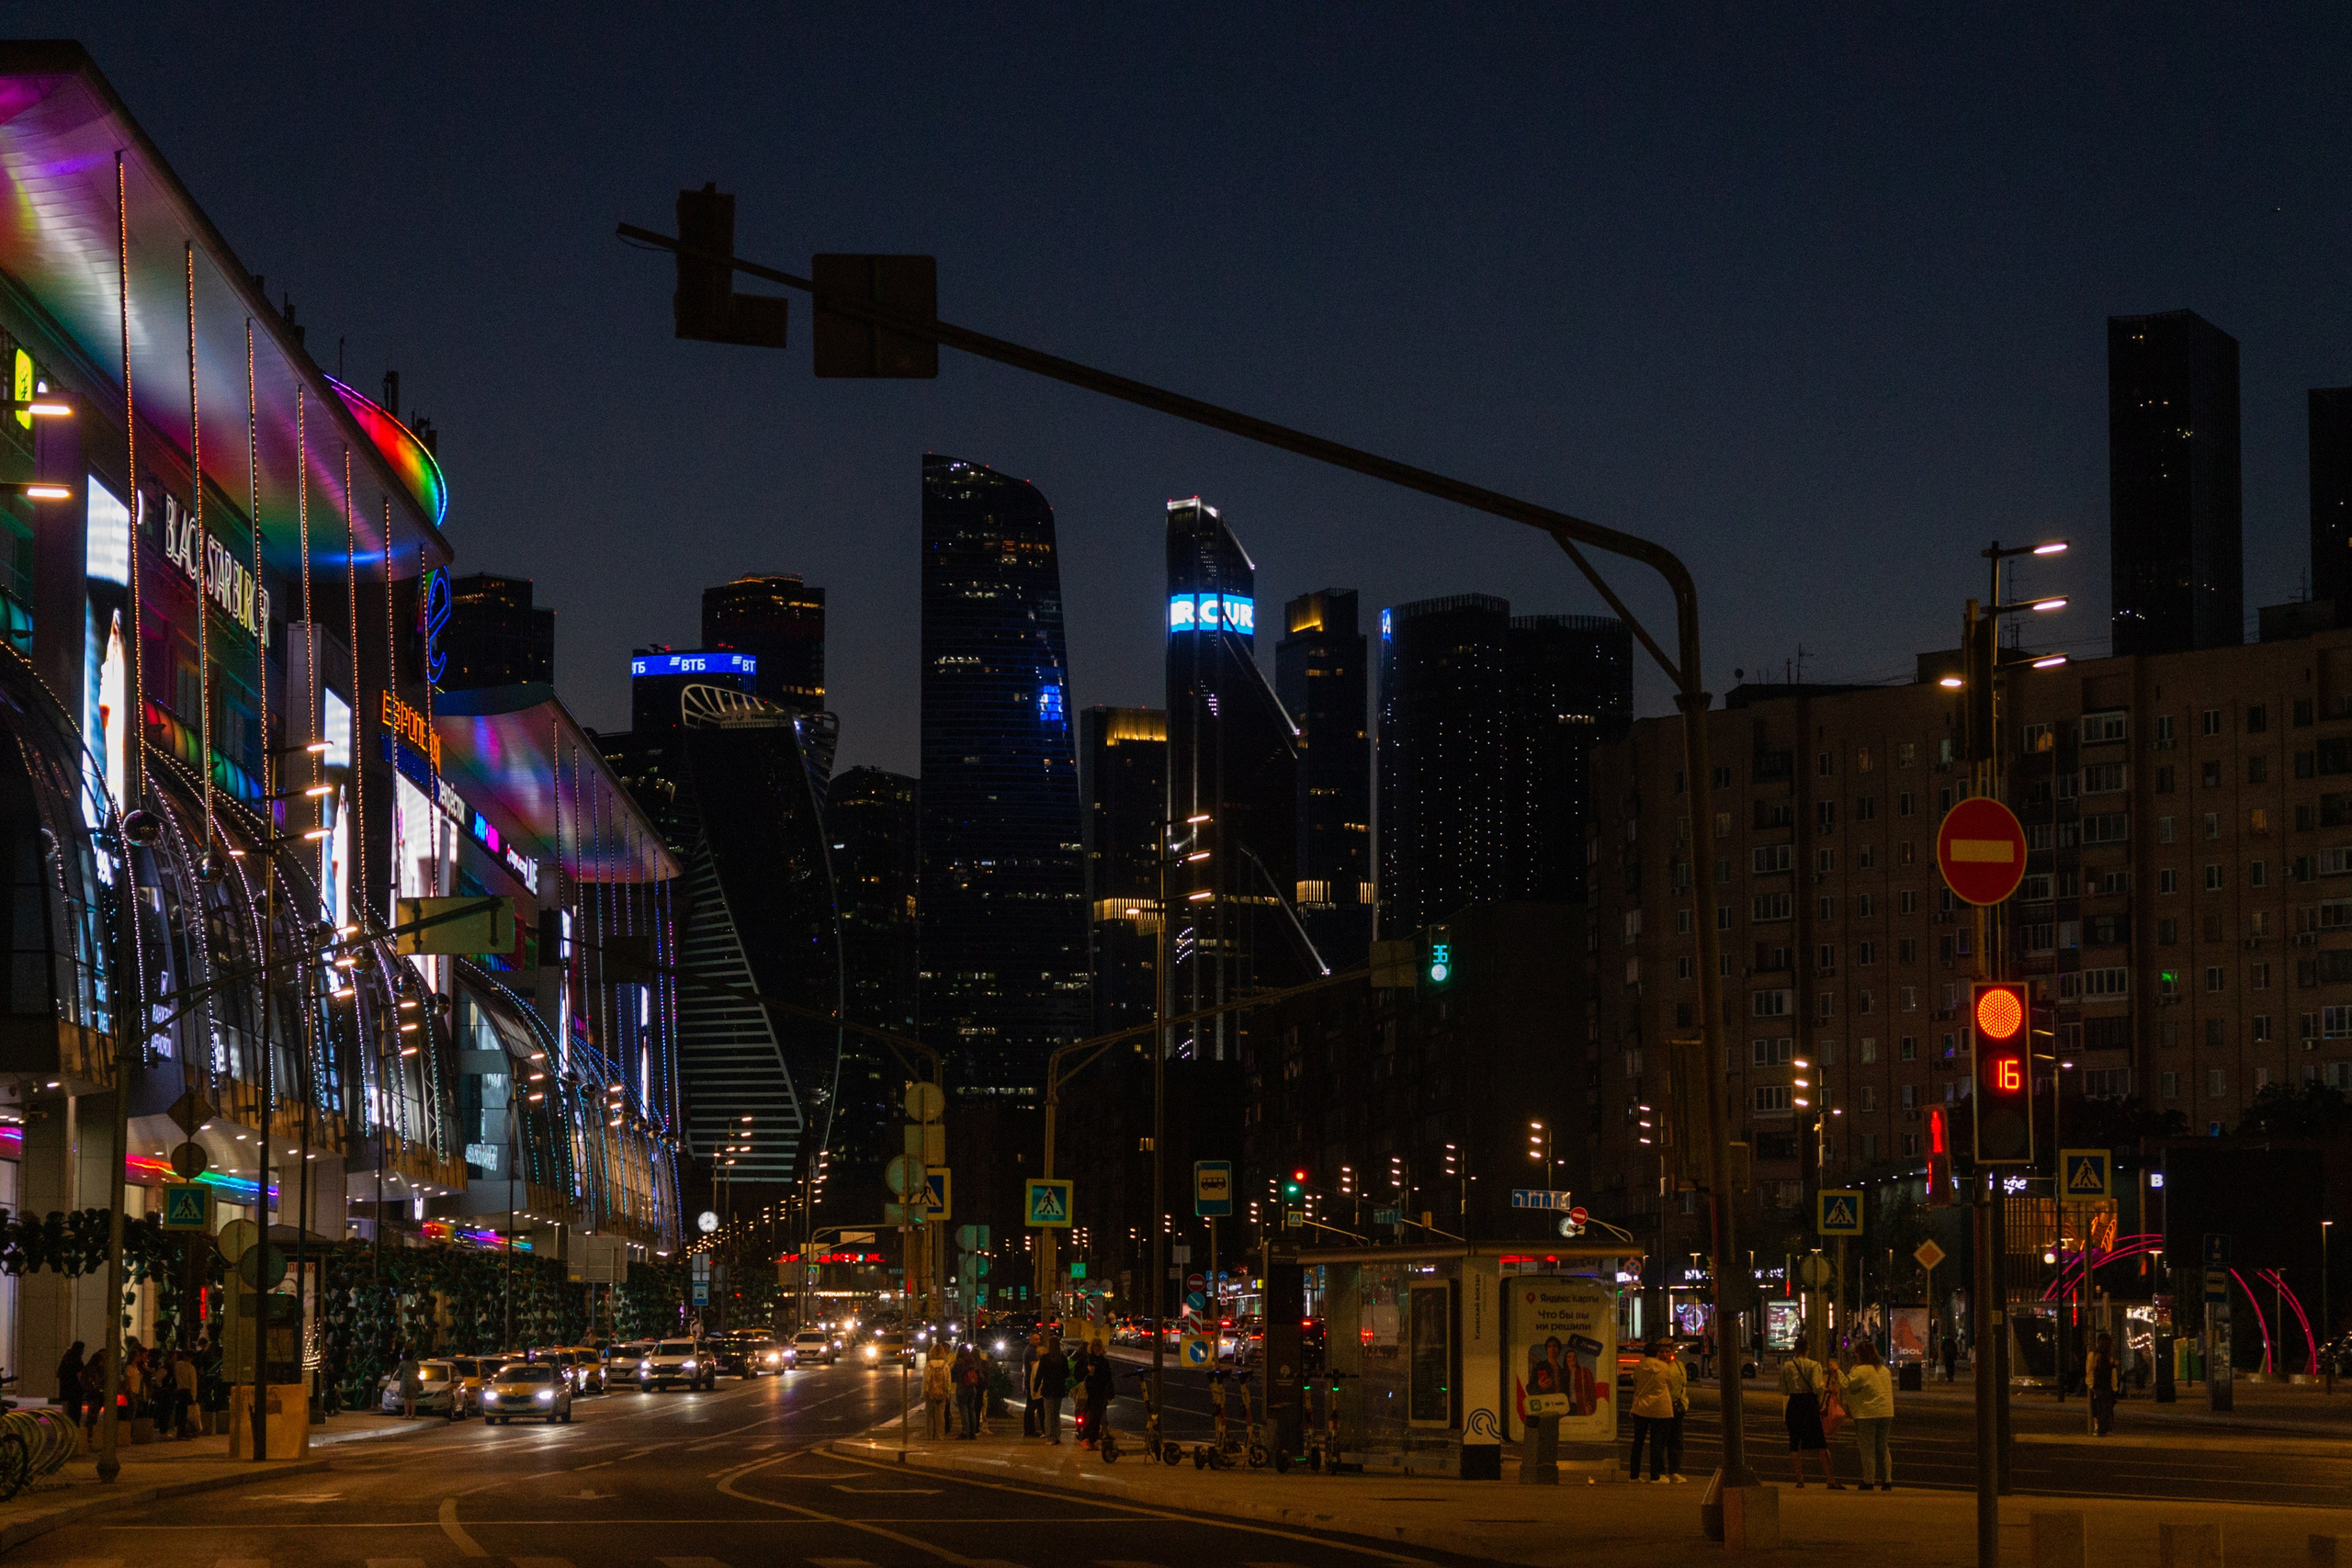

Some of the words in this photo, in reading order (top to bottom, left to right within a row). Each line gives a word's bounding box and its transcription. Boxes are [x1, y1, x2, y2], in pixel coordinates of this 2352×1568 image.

[166, 493, 203, 584] BLAC
[207, 534, 232, 614] STAR
[681, 659, 706, 671] ВТБ
[1433, 945, 1448, 963] 36
[1999, 1060, 2019, 1089] 16
[1540, 1293, 1570, 1303] Яндекс
[1572, 1294, 1599, 1303] Карты
[1538, 1310, 1557, 1319] Что
[1559, 1309, 1574, 1319] бы
[1551, 1323, 1591, 1332] решили
